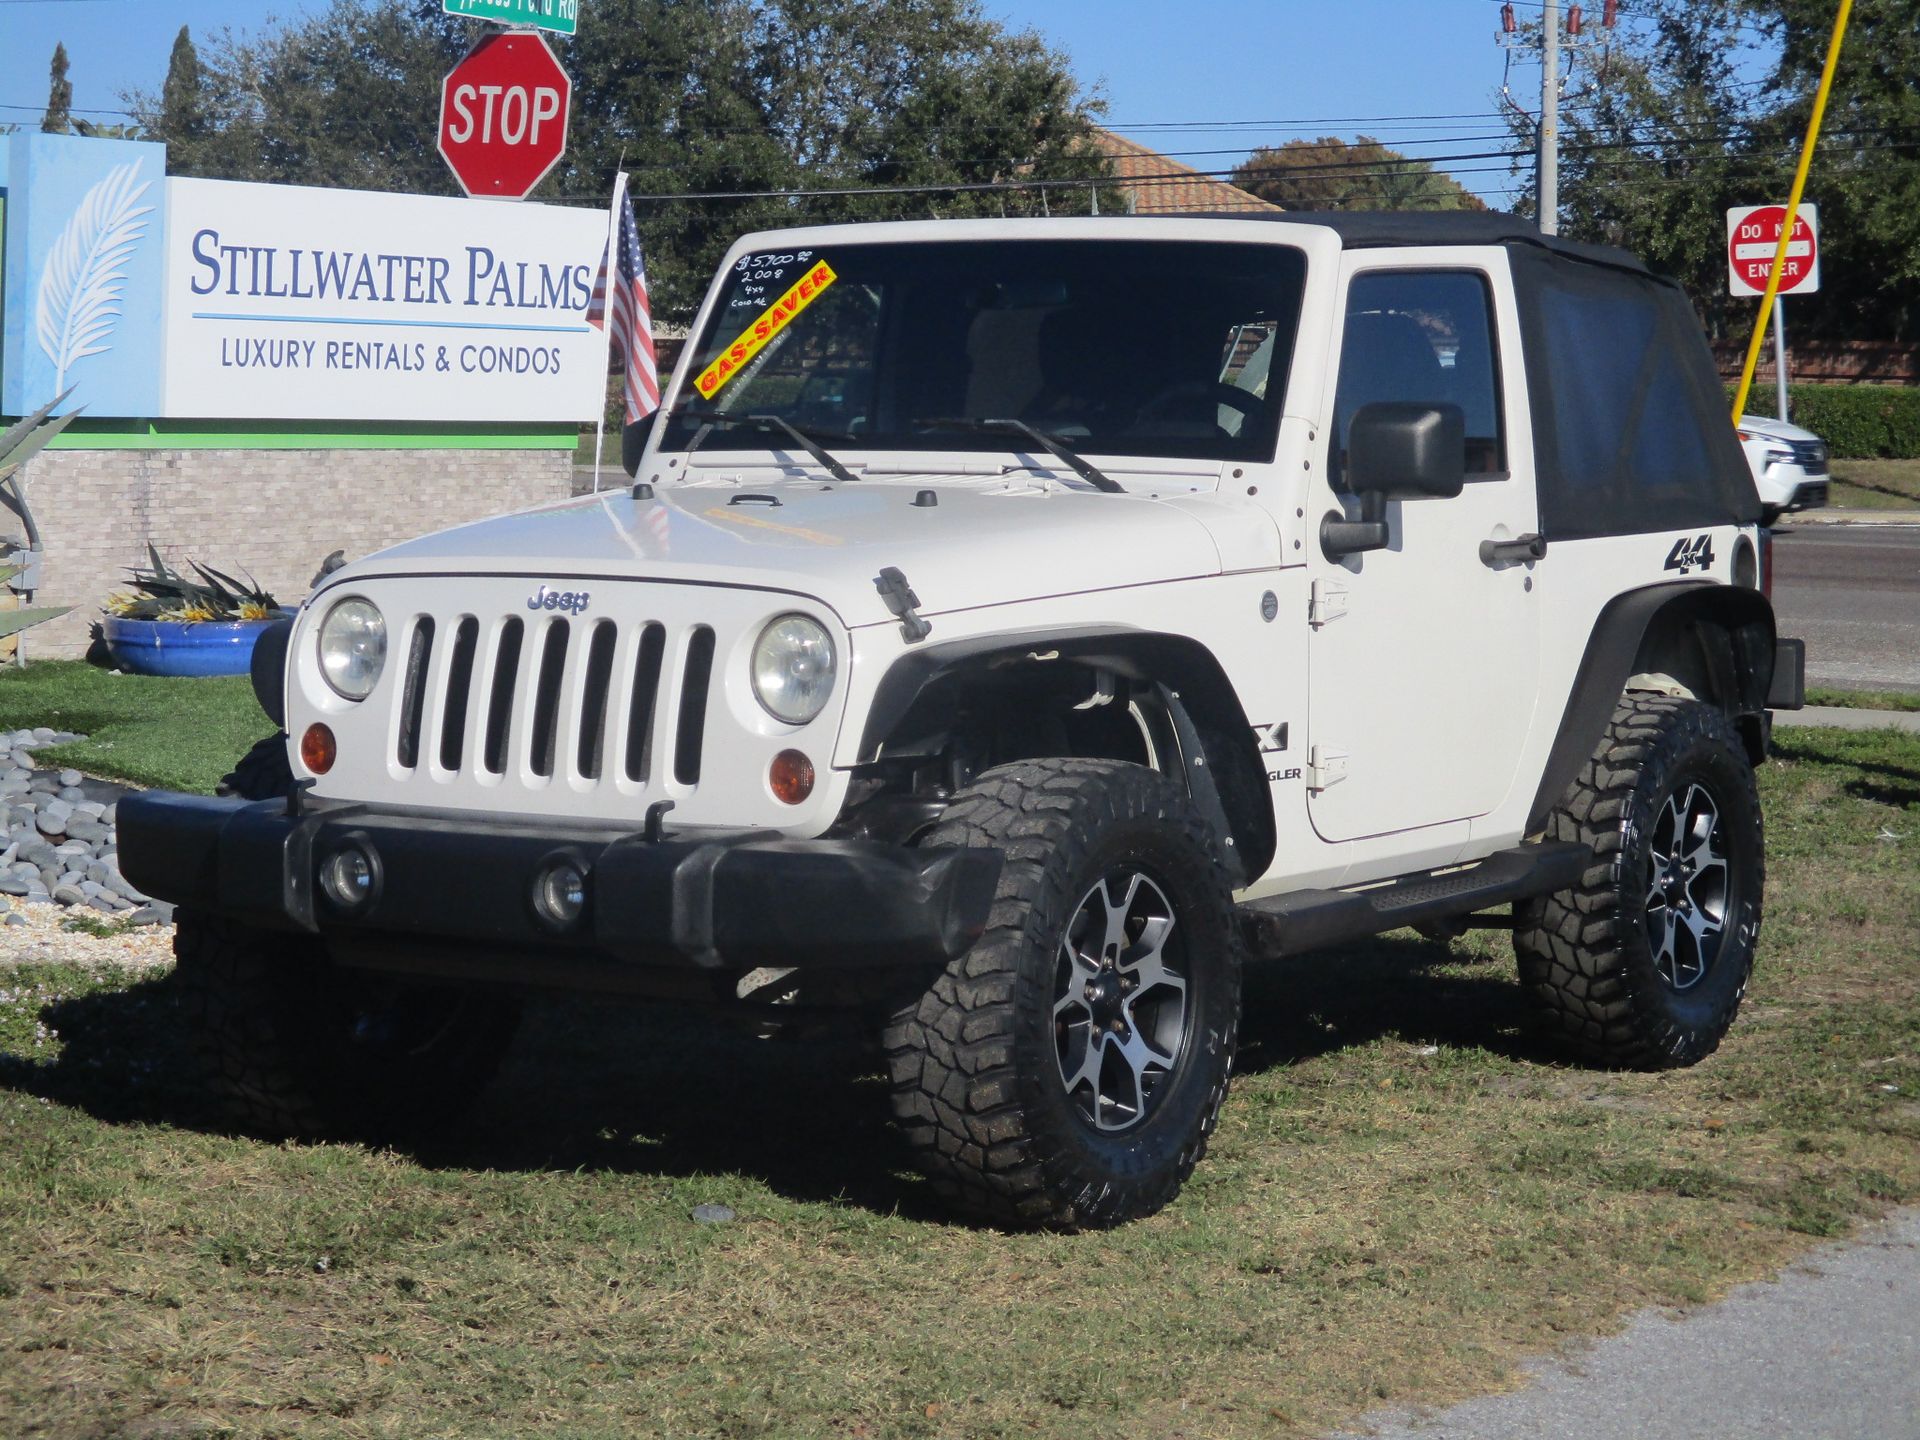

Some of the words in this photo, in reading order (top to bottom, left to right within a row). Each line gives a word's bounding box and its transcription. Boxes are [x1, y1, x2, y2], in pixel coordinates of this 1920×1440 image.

[449, 84, 560, 146] STOP
[1741, 224, 1762, 239] DO
[191, 229, 452, 304] STILLWATER
[463, 246, 592, 311] PALMS
[700, 266, 831, 392] GAS-SAVER
[222, 337, 316, 369] LUXURY
[325, 340, 425, 372] RENTALS
[435, 345, 451, 372] &
[460, 344, 561, 375] CONDOS
[527, 584, 591, 616] Jeep
